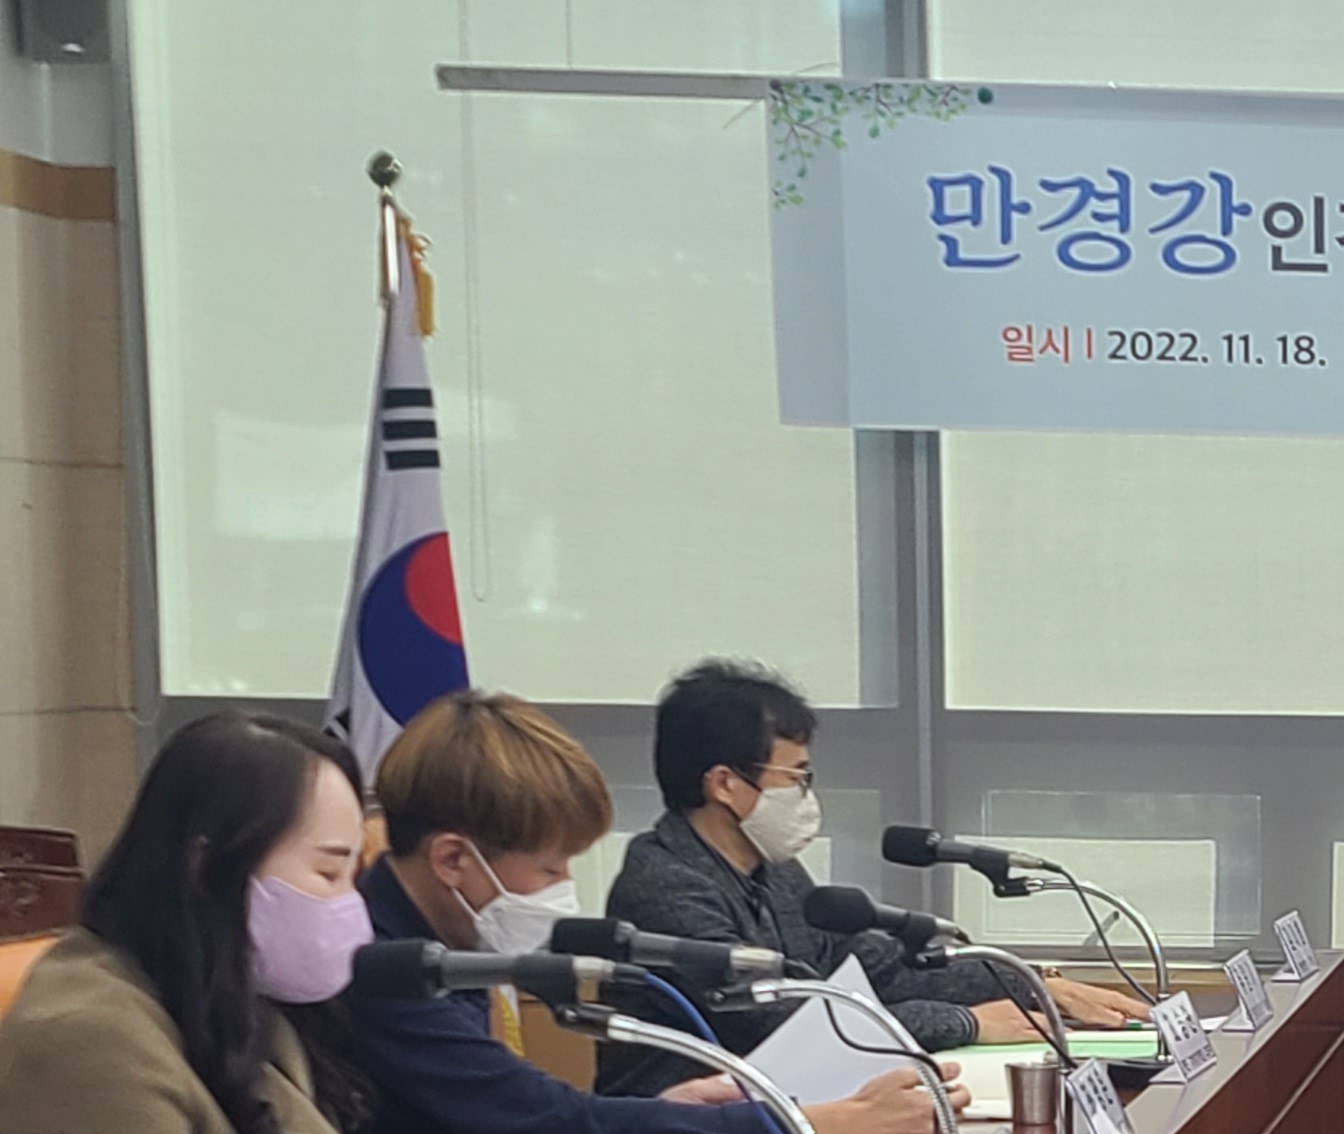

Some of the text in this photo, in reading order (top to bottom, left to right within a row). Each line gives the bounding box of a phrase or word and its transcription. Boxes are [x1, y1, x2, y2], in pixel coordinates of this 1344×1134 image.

[926, 164, 1252, 276] 만경강
[1001, 324, 1327, 366] 일시 2022. 11. 18.
